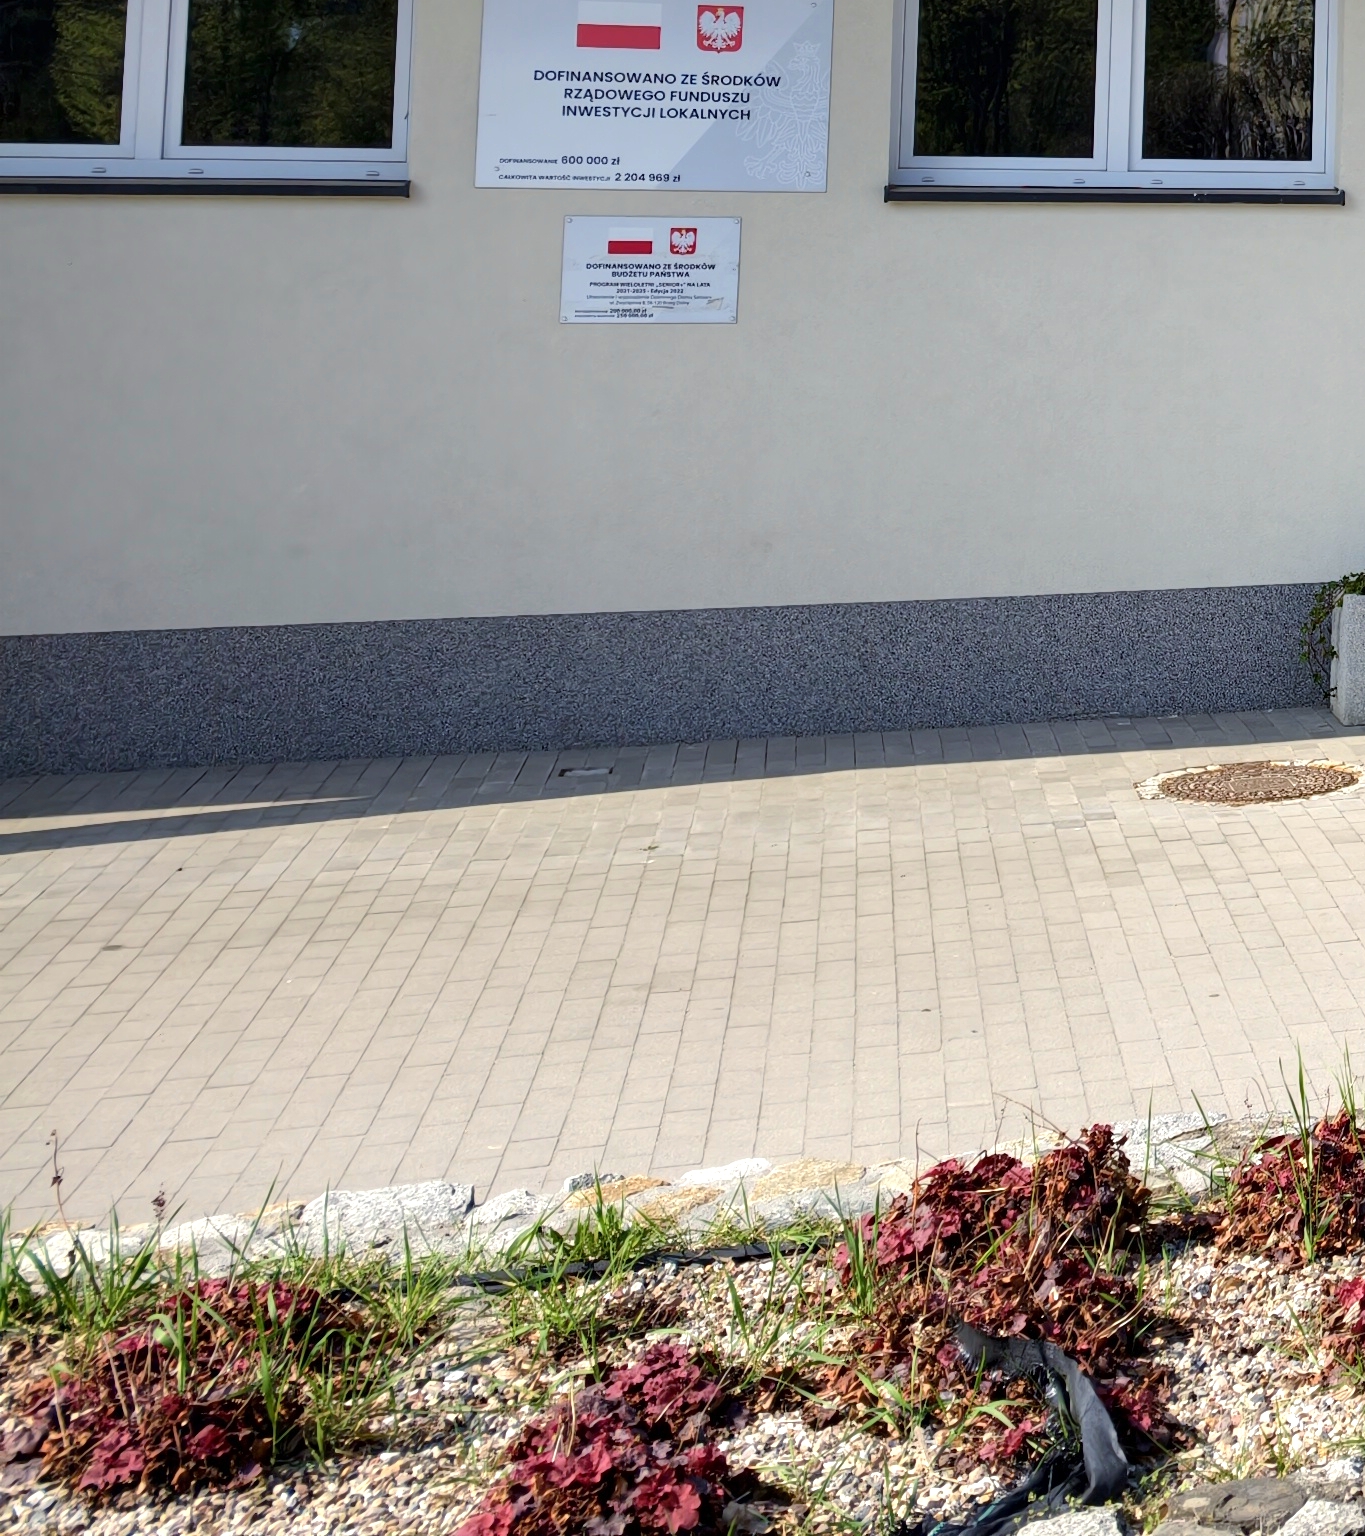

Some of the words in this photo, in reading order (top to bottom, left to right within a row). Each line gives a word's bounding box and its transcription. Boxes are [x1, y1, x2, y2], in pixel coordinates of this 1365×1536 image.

[533, 70, 677, 85] DOFINANSOWANO
[680, 74, 698, 85] ZE
[701, 71, 781, 87] ŚRODKÓW
[564, 88, 666, 102] RZĄDOWEGO
[670, 91, 750, 103] FUNDUSZU
[562, 105, 655, 118] INWESTYCJI
[660, 108, 751, 120] LOKALNYCH
[561, 156, 583, 165] 600
[586, 156, 608, 165] 000
[611, 156, 620, 165] zł
[614, 173, 622, 182] 2
[624, 173, 645, 182] 204
[648, 173, 670, 182] 969
[673, 174, 681, 182] zł
[674, 262, 716, 270] ŚRODKÓW
[650, 270, 690, 278] PAŃSTWA
